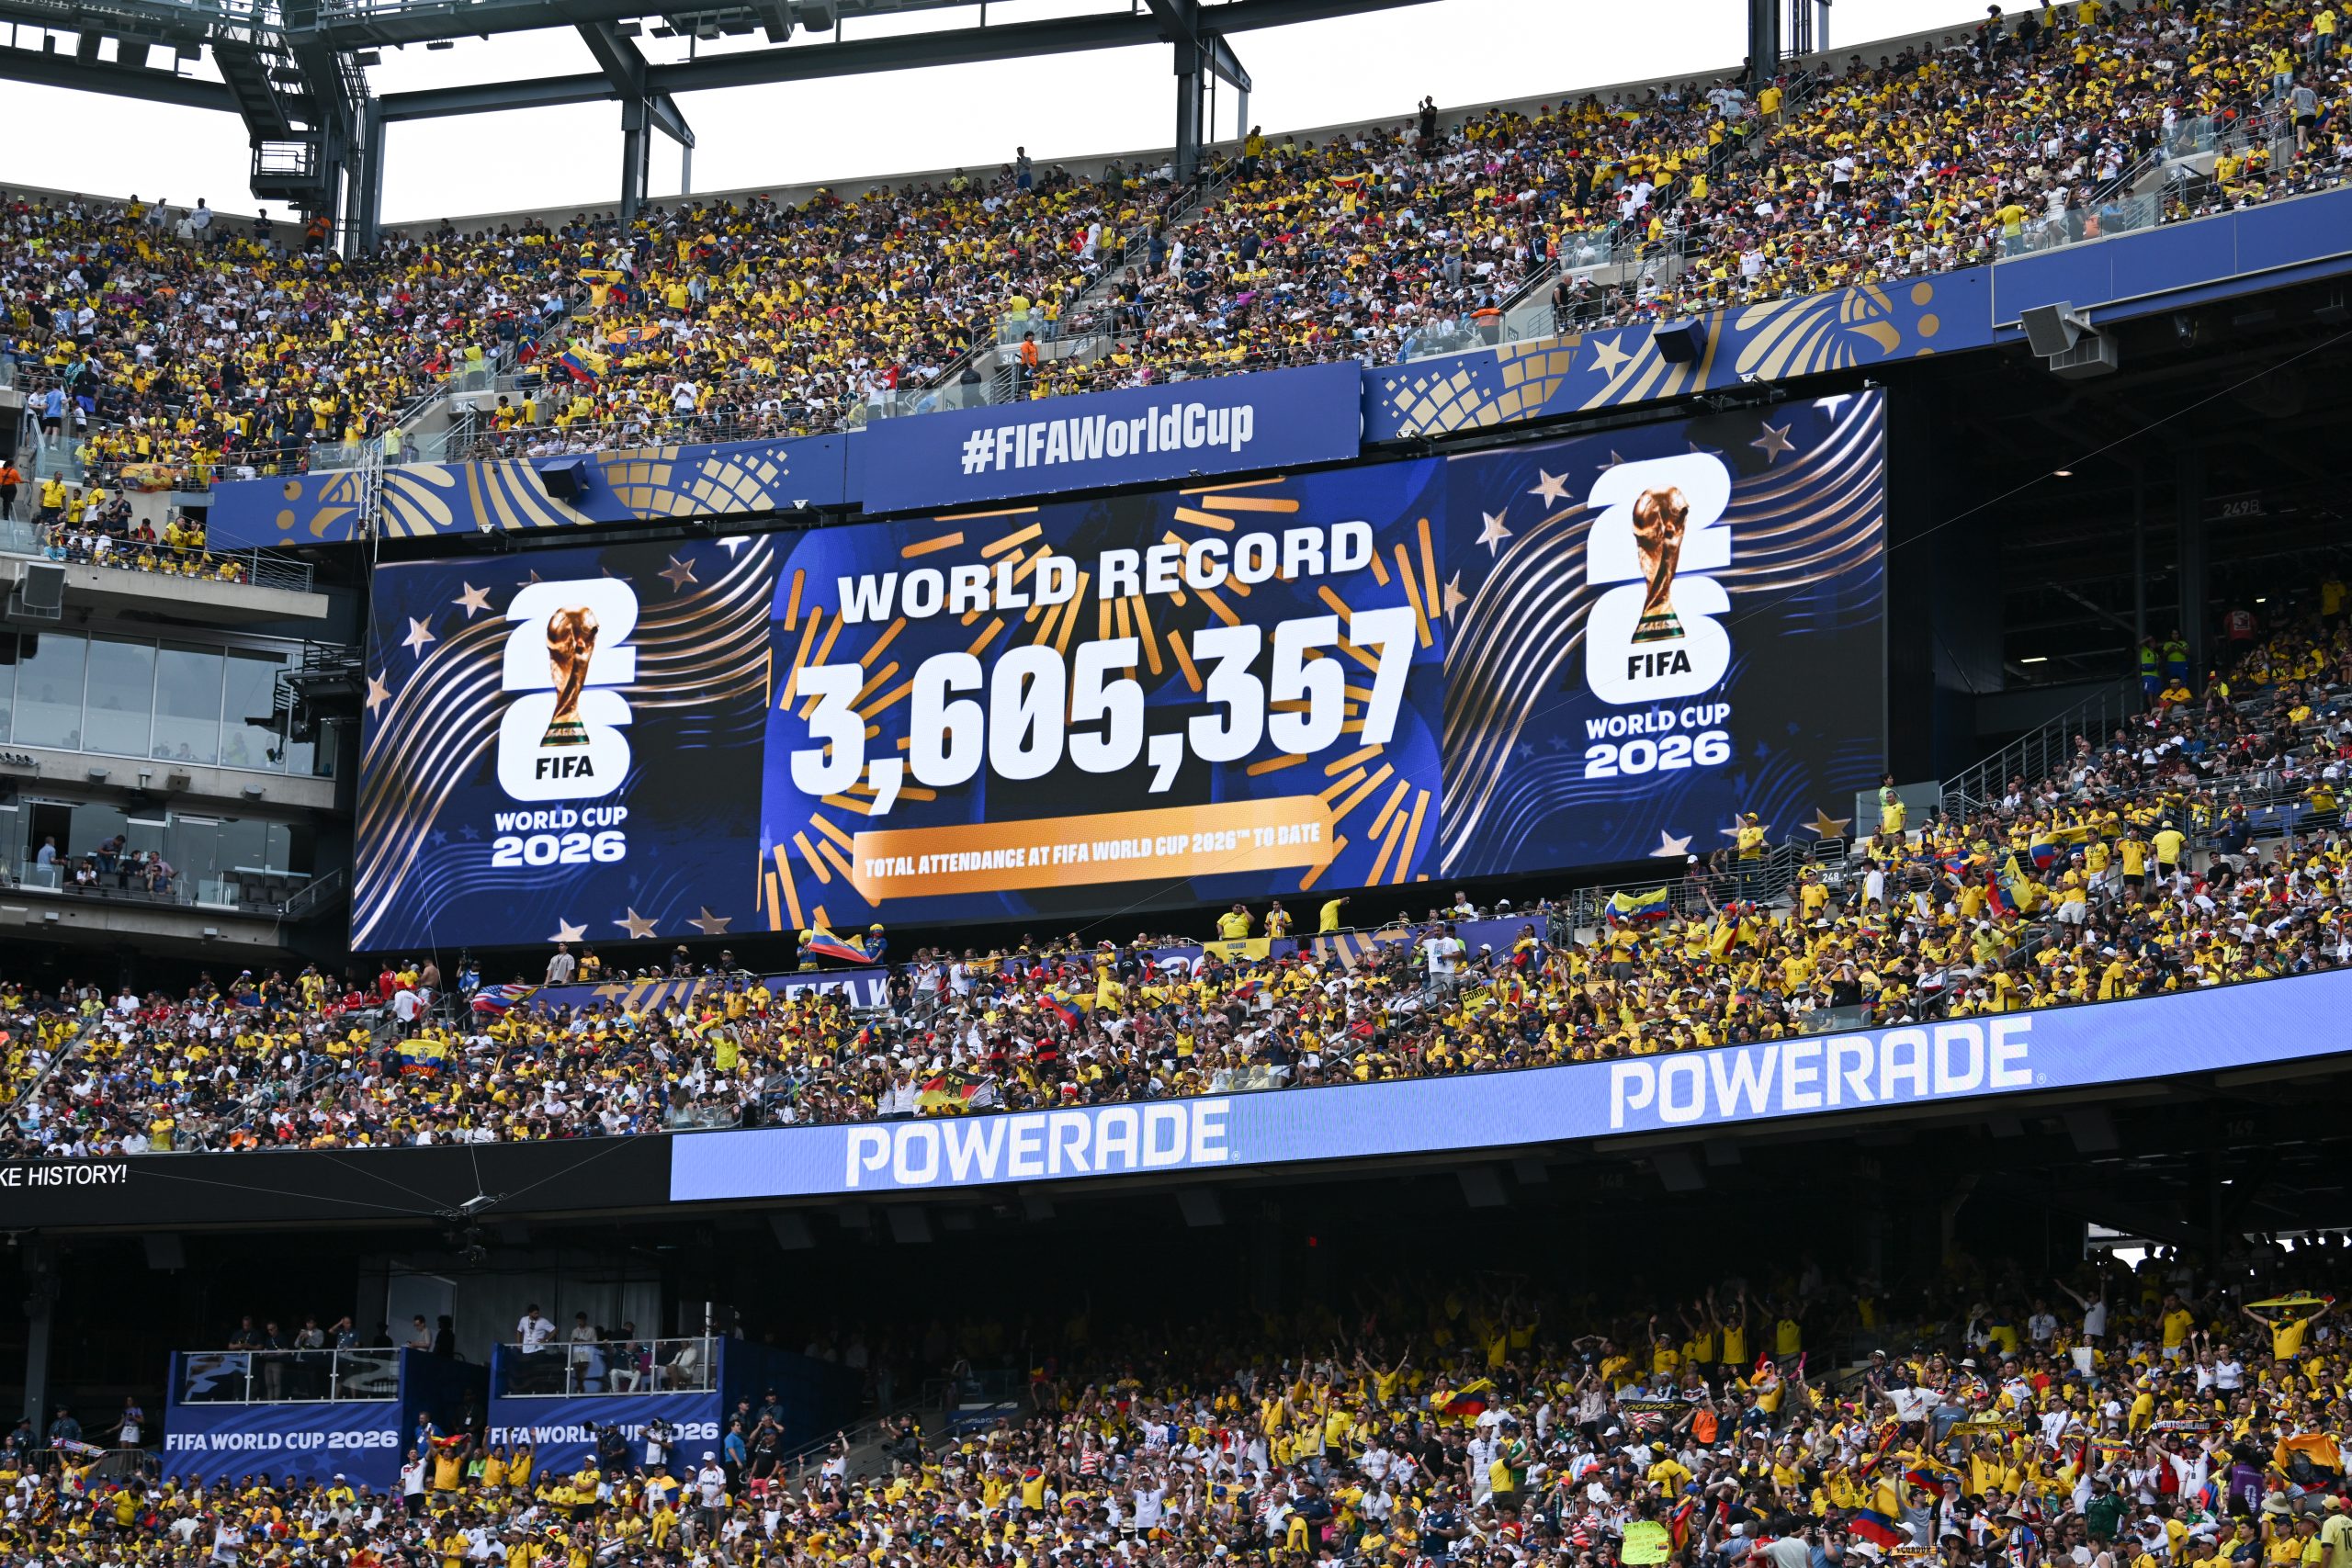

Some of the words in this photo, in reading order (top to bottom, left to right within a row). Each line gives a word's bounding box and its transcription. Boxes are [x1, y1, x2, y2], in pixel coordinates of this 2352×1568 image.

[2170, 169, 2192, 181] 38
[961, 402, 1254, 475] #FIFAWorldCup
[838, 556, 1077, 624] WORLD
[1099, 522, 1373, 600] RECORD
[1628, 649, 1691, 681] FIFA
[791, 606, 1417, 816] 3,605,357
[1586, 710, 1677, 739] WORLD
[1680, 703, 1730, 729] CUP
[536, 755, 594, 780] FIFA
[1585, 730, 1730, 780] 2026
[494, 809, 578, 832] WORLD
[582, 806, 628, 828] CUP
[492, 830, 626, 867] 2026
[865, 856, 915, 877] TOTAL
[918, 848, 1025, 874] ATTENDANCE
[1028, 846, 1050, 866] AT
[1053, 842, 1090, 864] FIFA
[1092, 838, 1152, 862] WORLD
[1155, 834, 1190, 856] CUP
[1253, 826, 1275, 848] TO
[1277, 822, 1320, 846] DATE
[1822, 872, 1840, 882] 248
[28, 1164, 128, 1186] HISTORY!
[491, 1427, 532, 1445] FIFA
[531, 1426, 597, 1444] WORL
[619, 1425, 646, 1442] UP
[671, 1422, 718, 1441] 026
[2157, 1420, 2211, 1430] DEUTSCHLAND
[166, 1434, 208, 1450] FIFA
[210, 1433, 282, 1450] WORLD
[285, 1432, 325, 1450] CUP
[327, 1430, 399, 1449] 2026
